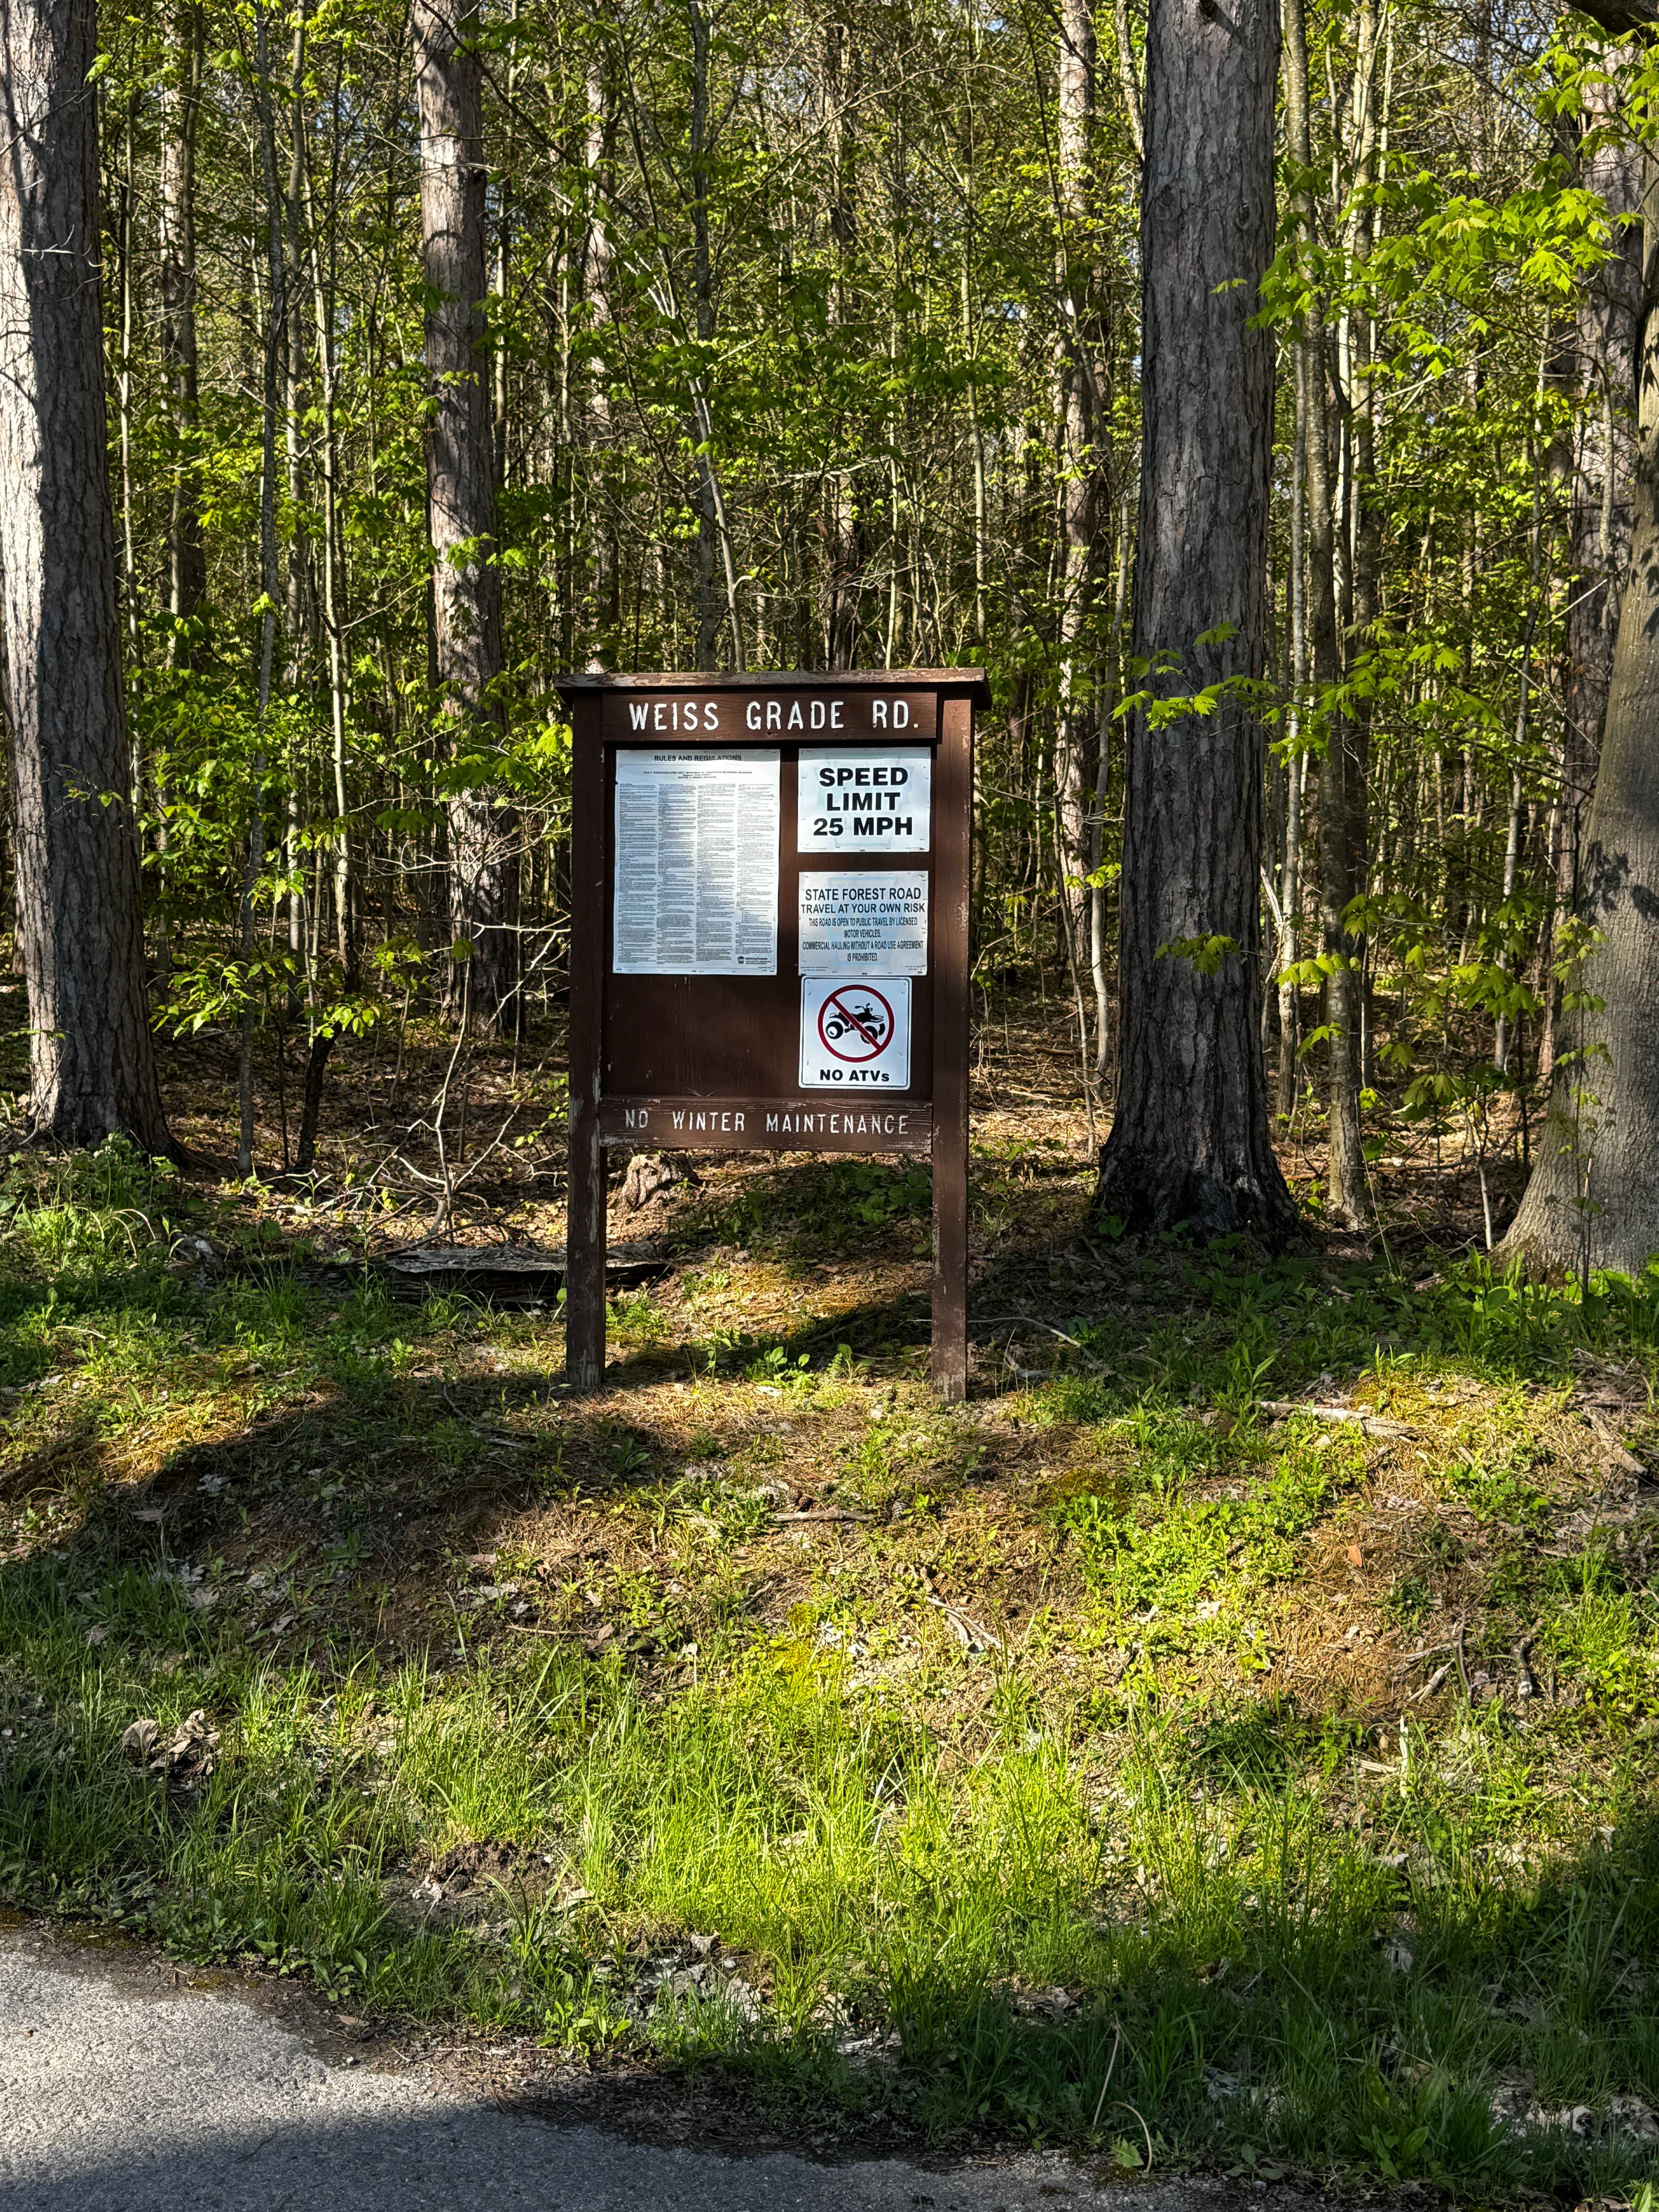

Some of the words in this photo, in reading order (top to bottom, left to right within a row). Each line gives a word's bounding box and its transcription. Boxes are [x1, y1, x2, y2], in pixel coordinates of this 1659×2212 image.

[629, 702, 719, 731] WEISS
[746, 701, 845, 730] GRADE
[872, 700, 919, 729] RD.
[819, 767, 908, 787] SPEED
[827, 792, 901, 811] LIMIT
[813, 818, 843, 836] 25
[854, 817, 912, 836] MPH
[805, 889, 839, 901] STATE
[842, 888, 886, 900] FOREST
[889, 887, 921, 900] ROAD
[800, 904, 836, 914] TRAVEL
[838, 904, 850, 913] AT
[851, 904, 876, 913] YOUR
[879, 903, 900, 912] OWN
[904, 903, 925, 912] RISK
[809, 918, 818, 926] THIS
[819, 918, 831, 926] ROAD
[832, 918, 836, 926] IS
[837, 918, 849, 926] OPEN
[850, 918, 855, 926] TO
[856, 917, 871, 926] PUBLIC
[872, 917, 888, 926] TRAVEL
[889, 917, 895, 926] BY
[896, 917, 917, 925] LICENSED
[844, 929, 859, 938] MOTOR
[860, 929, 881, 938] VEHICLES.
[802, 941, 830, 950] COMMERCIAL
[831, 941, 850, 950] HAULING
[851, 941, 870, 950] WITHOUT
[874, 941, 887, 949] ROAD
[888, 941, 896, 949] USE
[897, 941, 924, 949] AGREEMENT
[847, 953, 851, 962] IS
[852, 953, 879, 962] PROHIBITED.
[820, 1070, 843, 1081] NO
[849, 1070, 890, 1082] ATVs
[625, 1109, 647, 1128] NO
[672, 1110, 745, 1131] WINTER
[766, 1113, 908, 1135] MAINTENANCE
